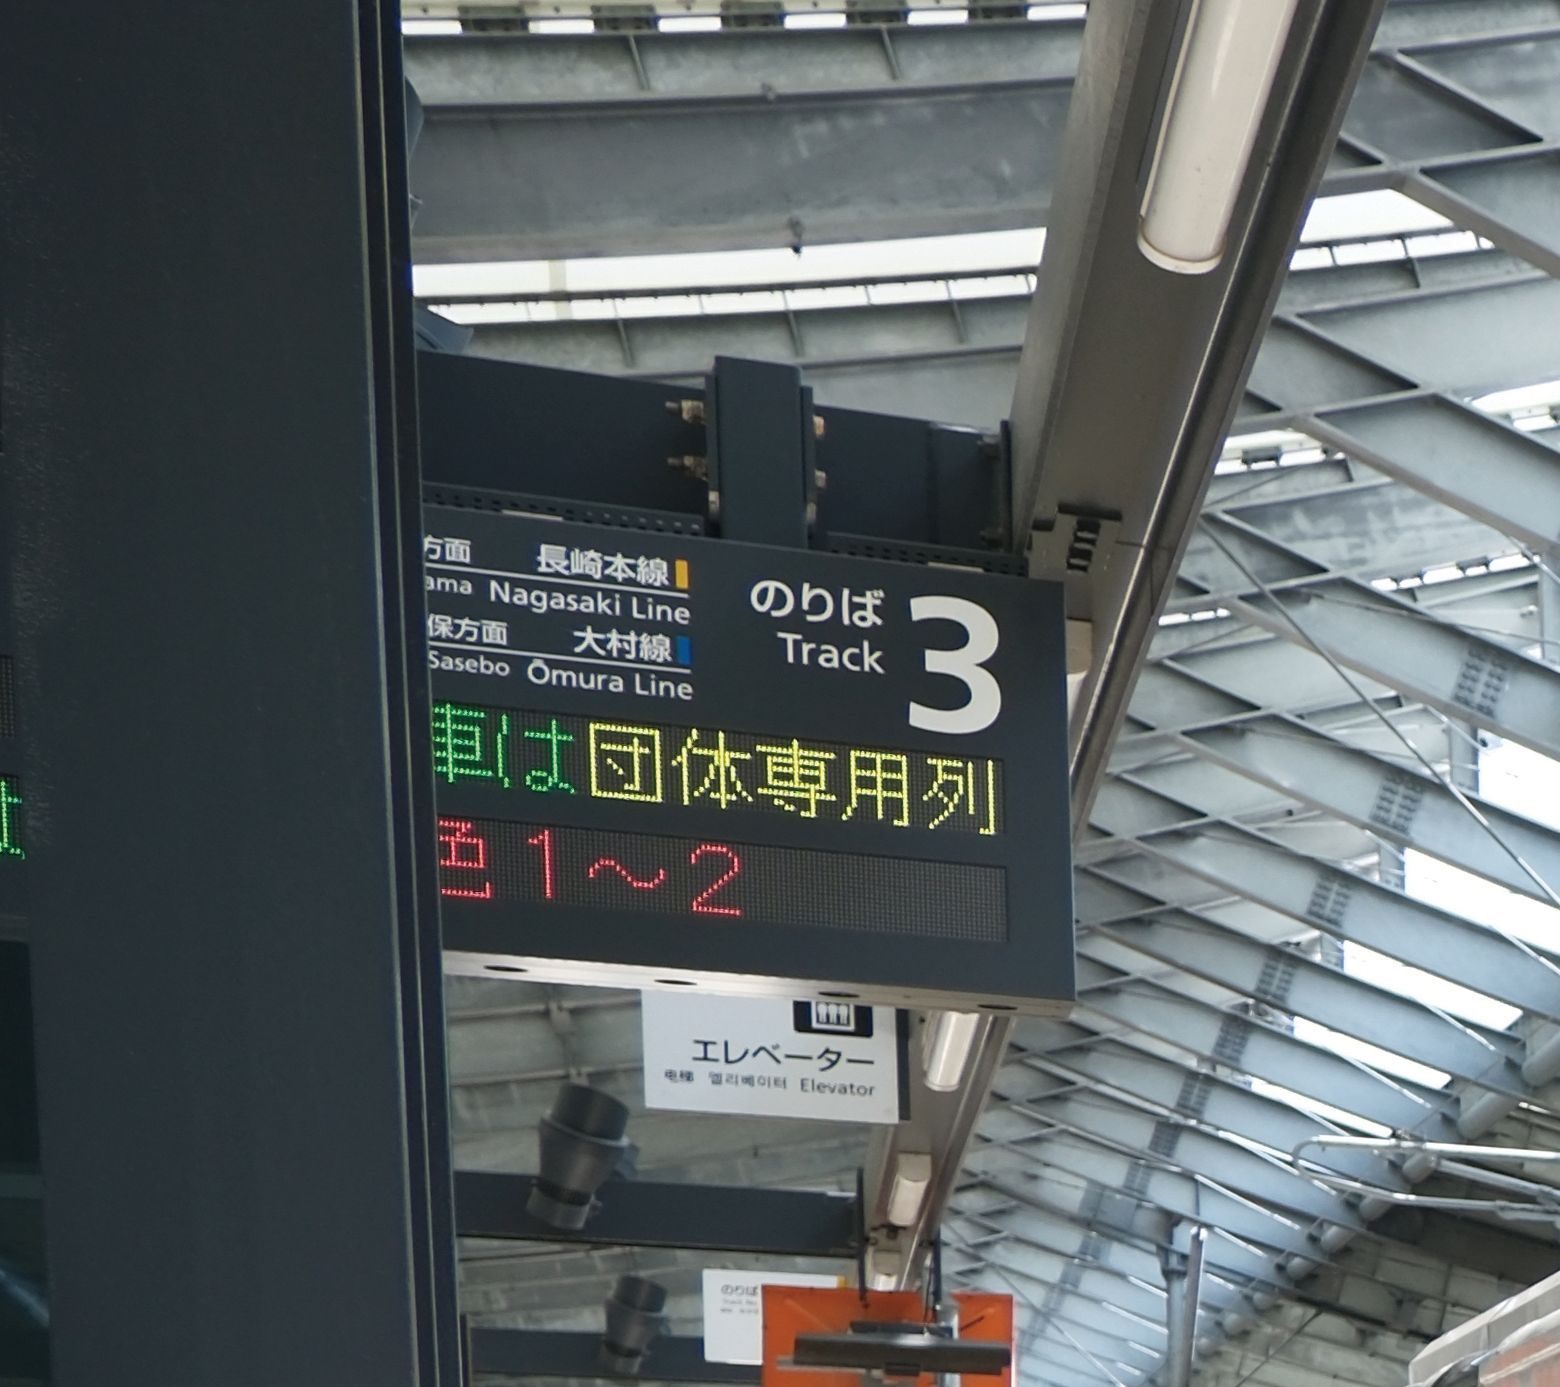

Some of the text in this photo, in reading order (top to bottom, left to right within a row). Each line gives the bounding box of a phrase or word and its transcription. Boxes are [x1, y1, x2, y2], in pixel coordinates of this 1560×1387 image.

[537, 543, 669, 587] 長崎本線
[489, 580, 621, 614] Nagasaki
[631, 597, 691, 625] Line
[750, 579, 885, 628] のりば
[573, 626, 673, 663] 大村線
[776, 631, 886, 675] Track
[908, 595, 1002, 735] 3
[428, 650, 693, 700] Sasebo Ōmura Line
[692, 1040, 875, 1072] エレベーター
[800, 1078, 876, 1097] Elevator
